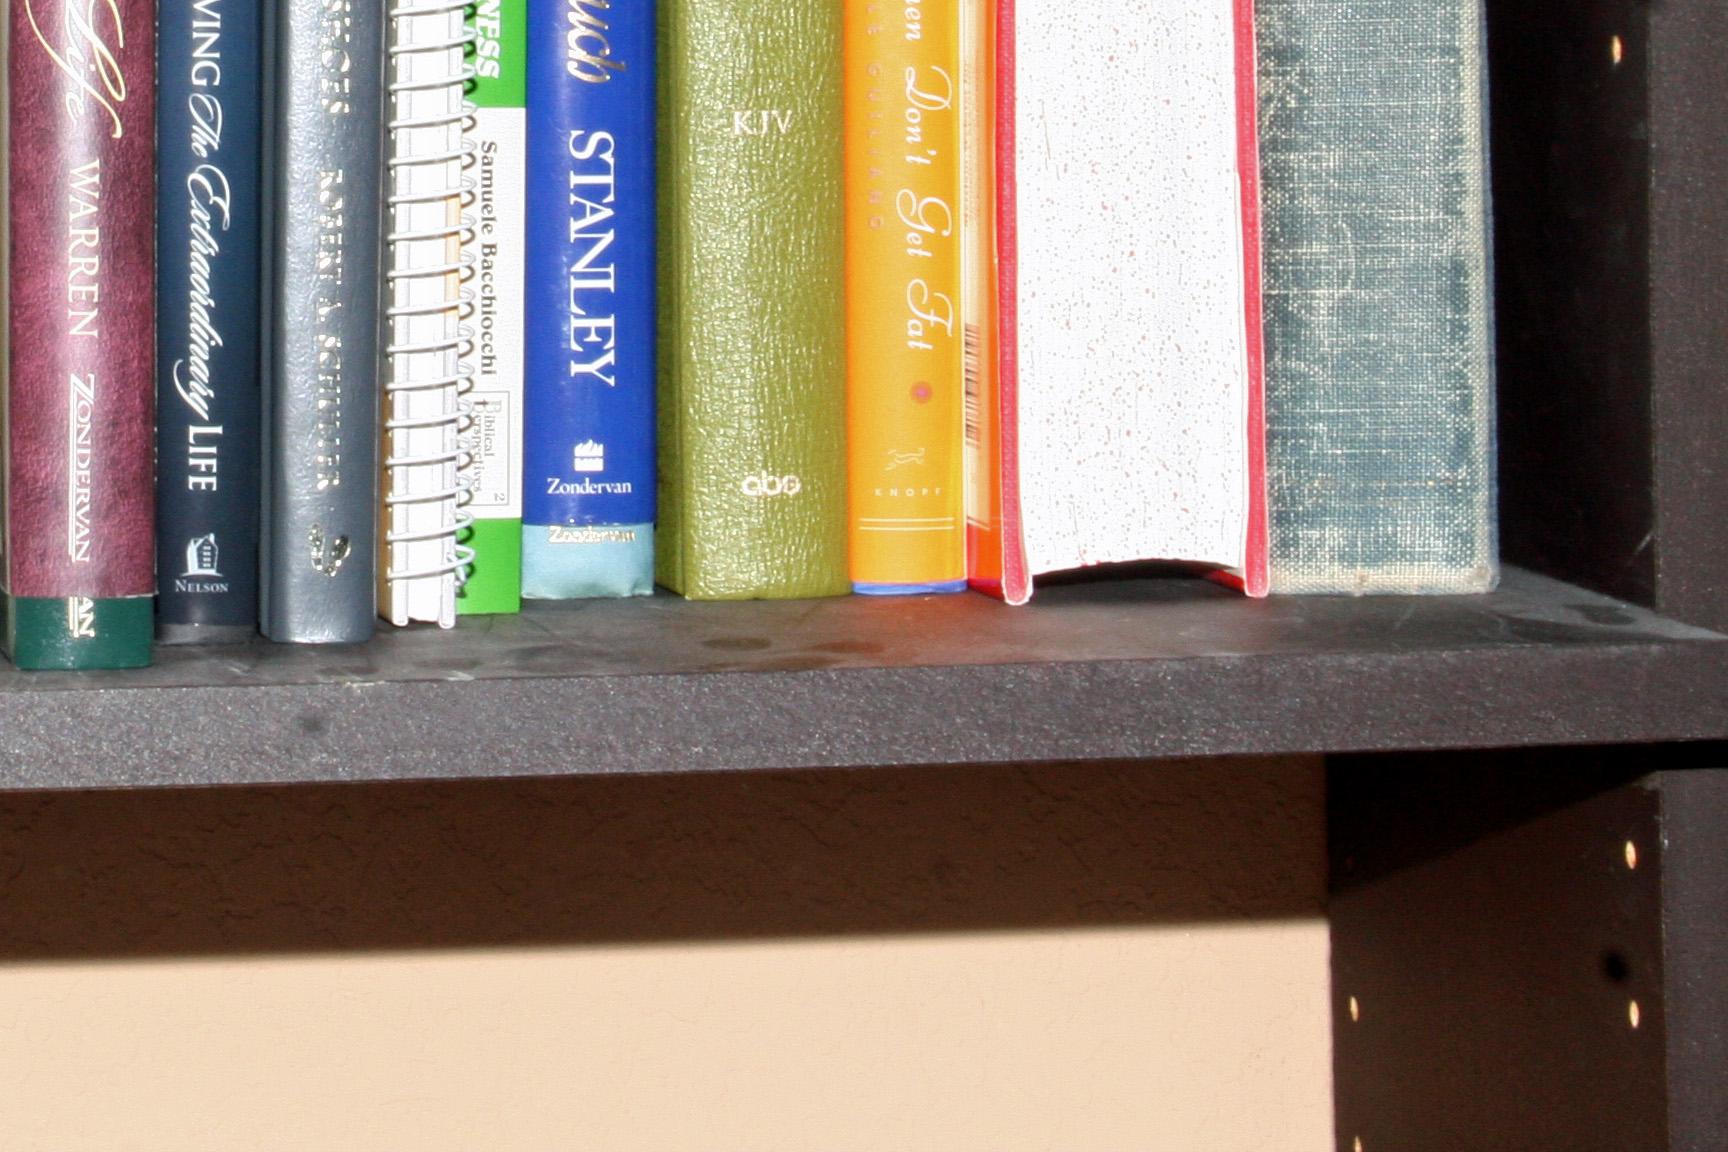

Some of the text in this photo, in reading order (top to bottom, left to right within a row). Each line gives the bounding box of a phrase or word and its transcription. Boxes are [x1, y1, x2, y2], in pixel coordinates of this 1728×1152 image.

[186, 93, 223, 158] The
[734, 110, 793, 138] KJV
[904, 64, 953, 165] Don't
[68, 158, 101, 340] WARREN
[480, 141, 499, 375] Samuele Bacchiocchi
[568, 129, 616, 387] STANLEY
[895, 188, 953, 258] Get
[173, 164, 231, 421] Extraordinary
[906, 278, 953, 349] Fat
[69, 372, 94, 563] ZONDERVAN
[188, 424, 222, 492] LIFE
[547, 477, 632, 495] Zondervan
[874, 487, 942, 497] KNOPF
[174, 579, 229, 593] NELSON
